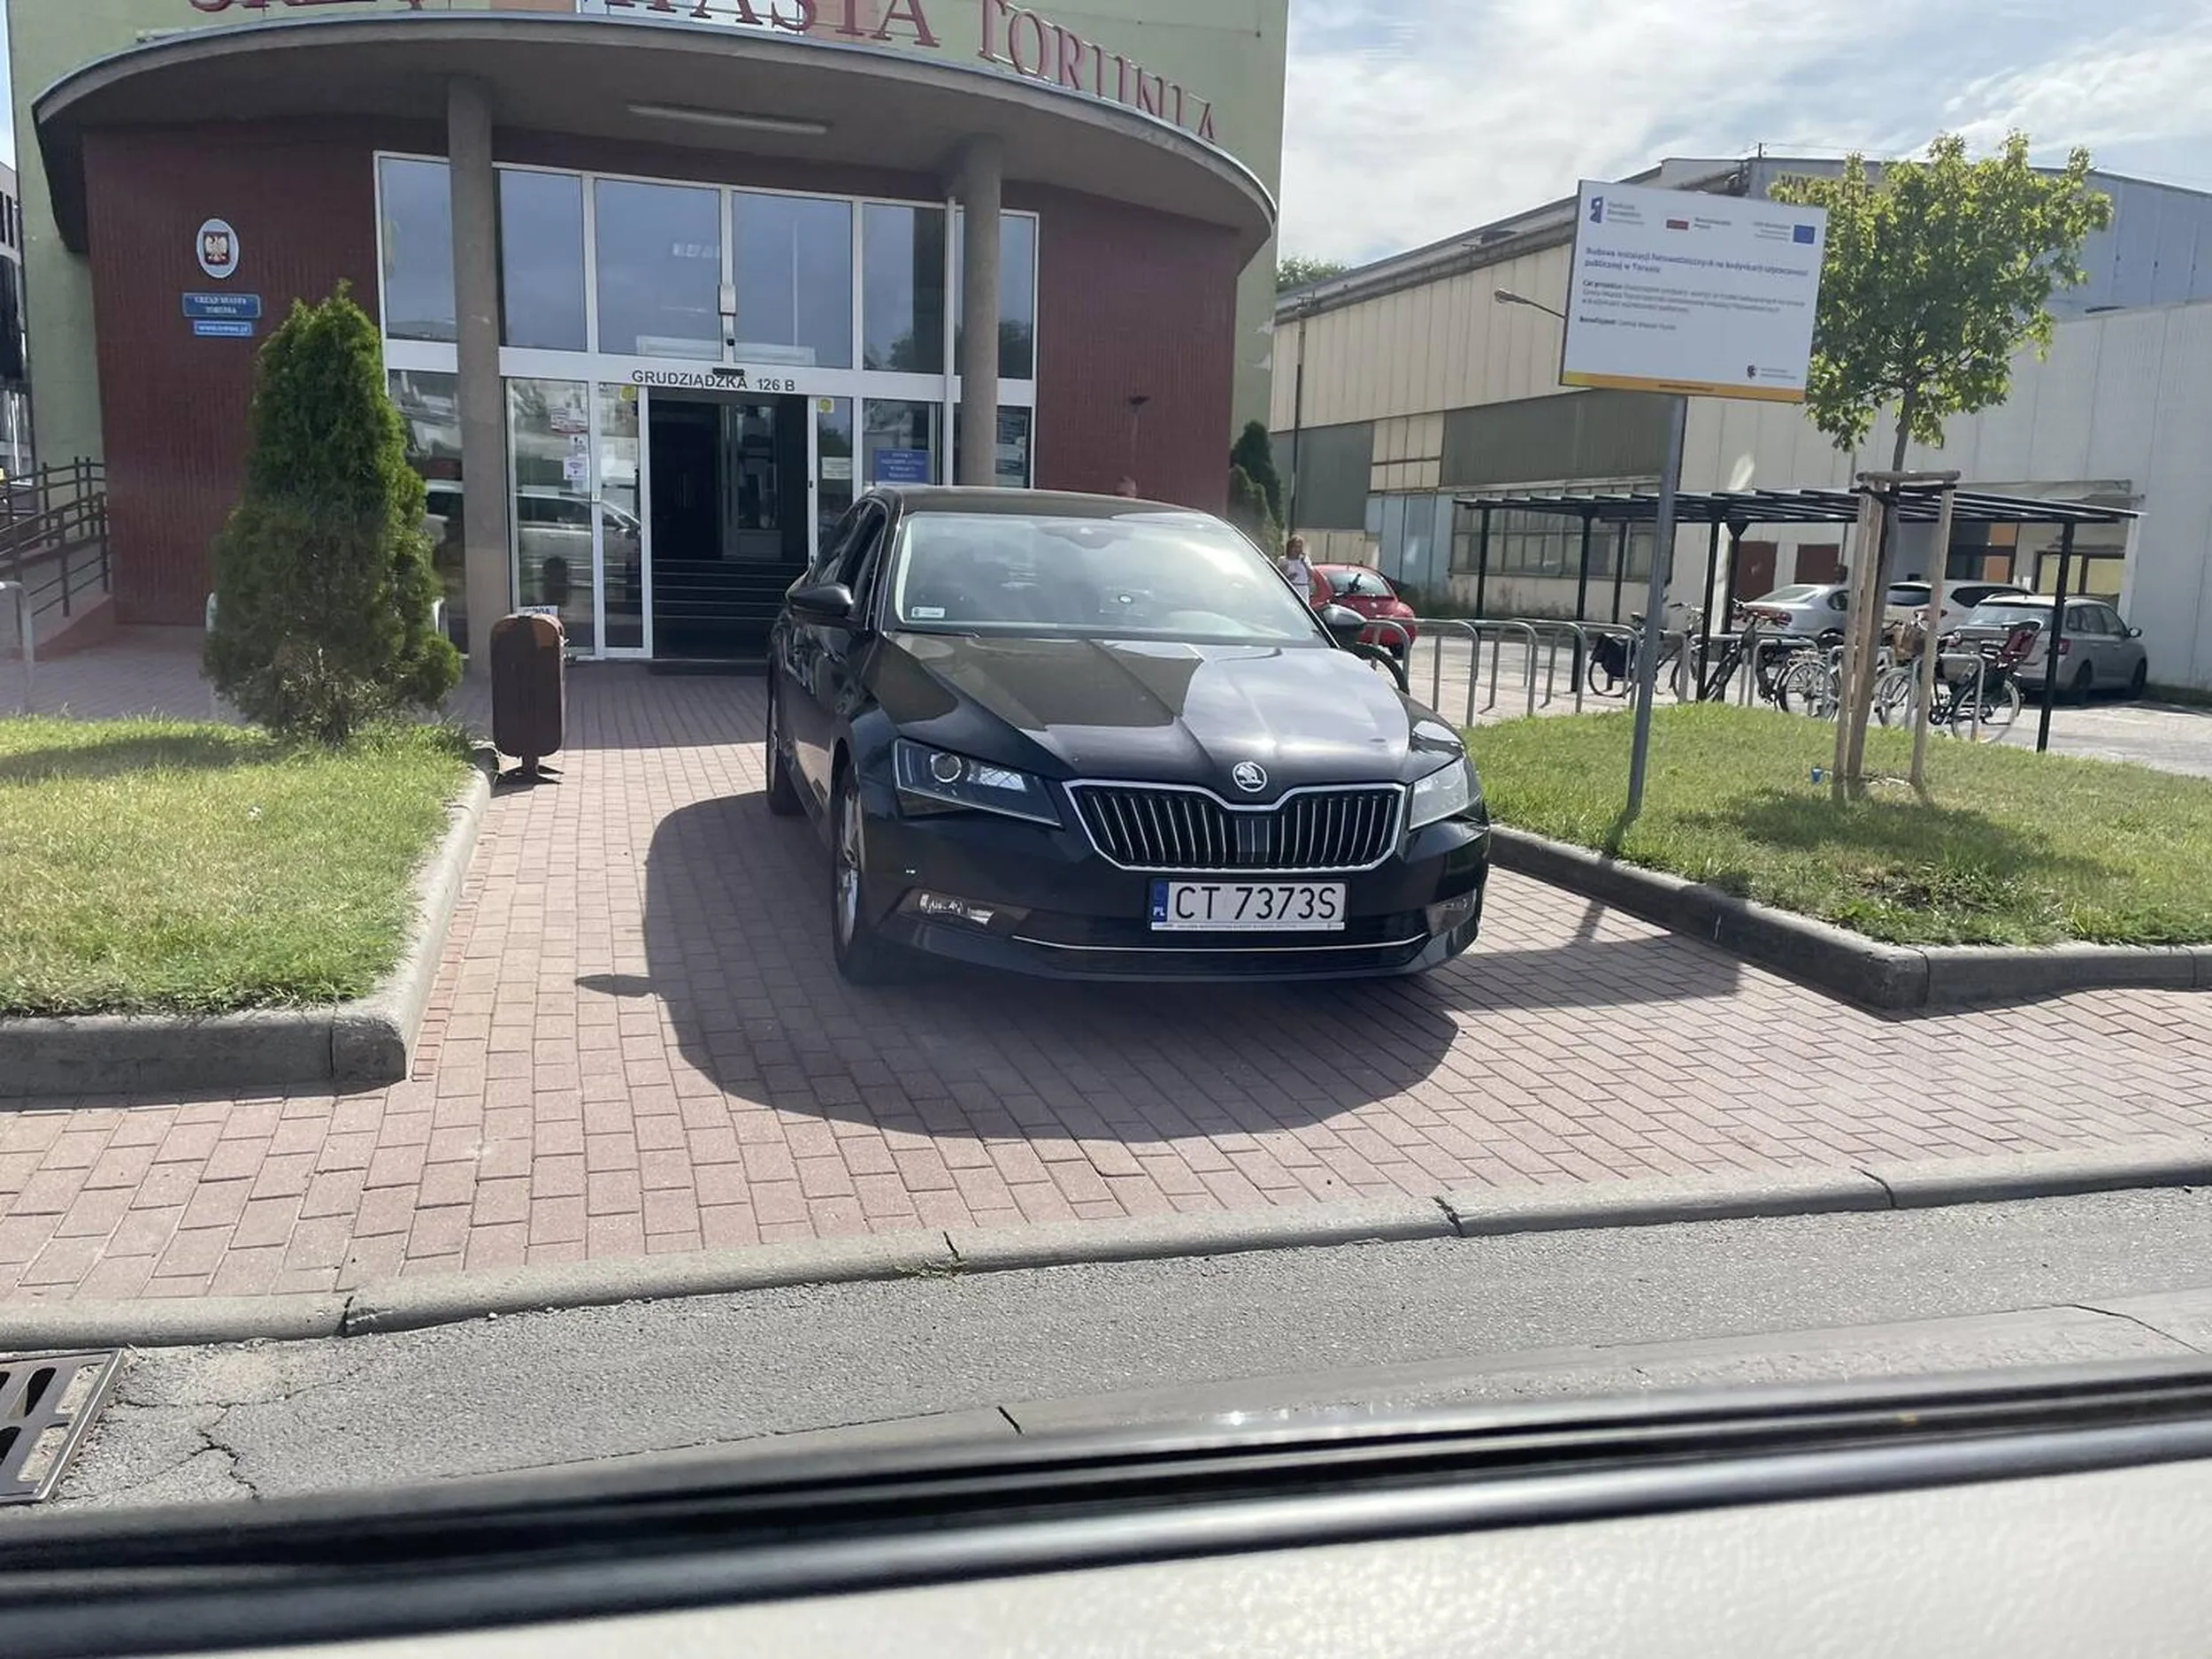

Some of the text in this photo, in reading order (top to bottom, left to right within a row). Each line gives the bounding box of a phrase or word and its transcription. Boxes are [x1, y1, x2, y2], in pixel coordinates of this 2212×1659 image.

[979, 0, 1215, 144] TORUNIA
[632, 370, 795, 392] GRUDZIĄDZKA 126 B
[1153, 906, 1165, 917] PL
[1176, 887, 1337, 920] CT 7373S
